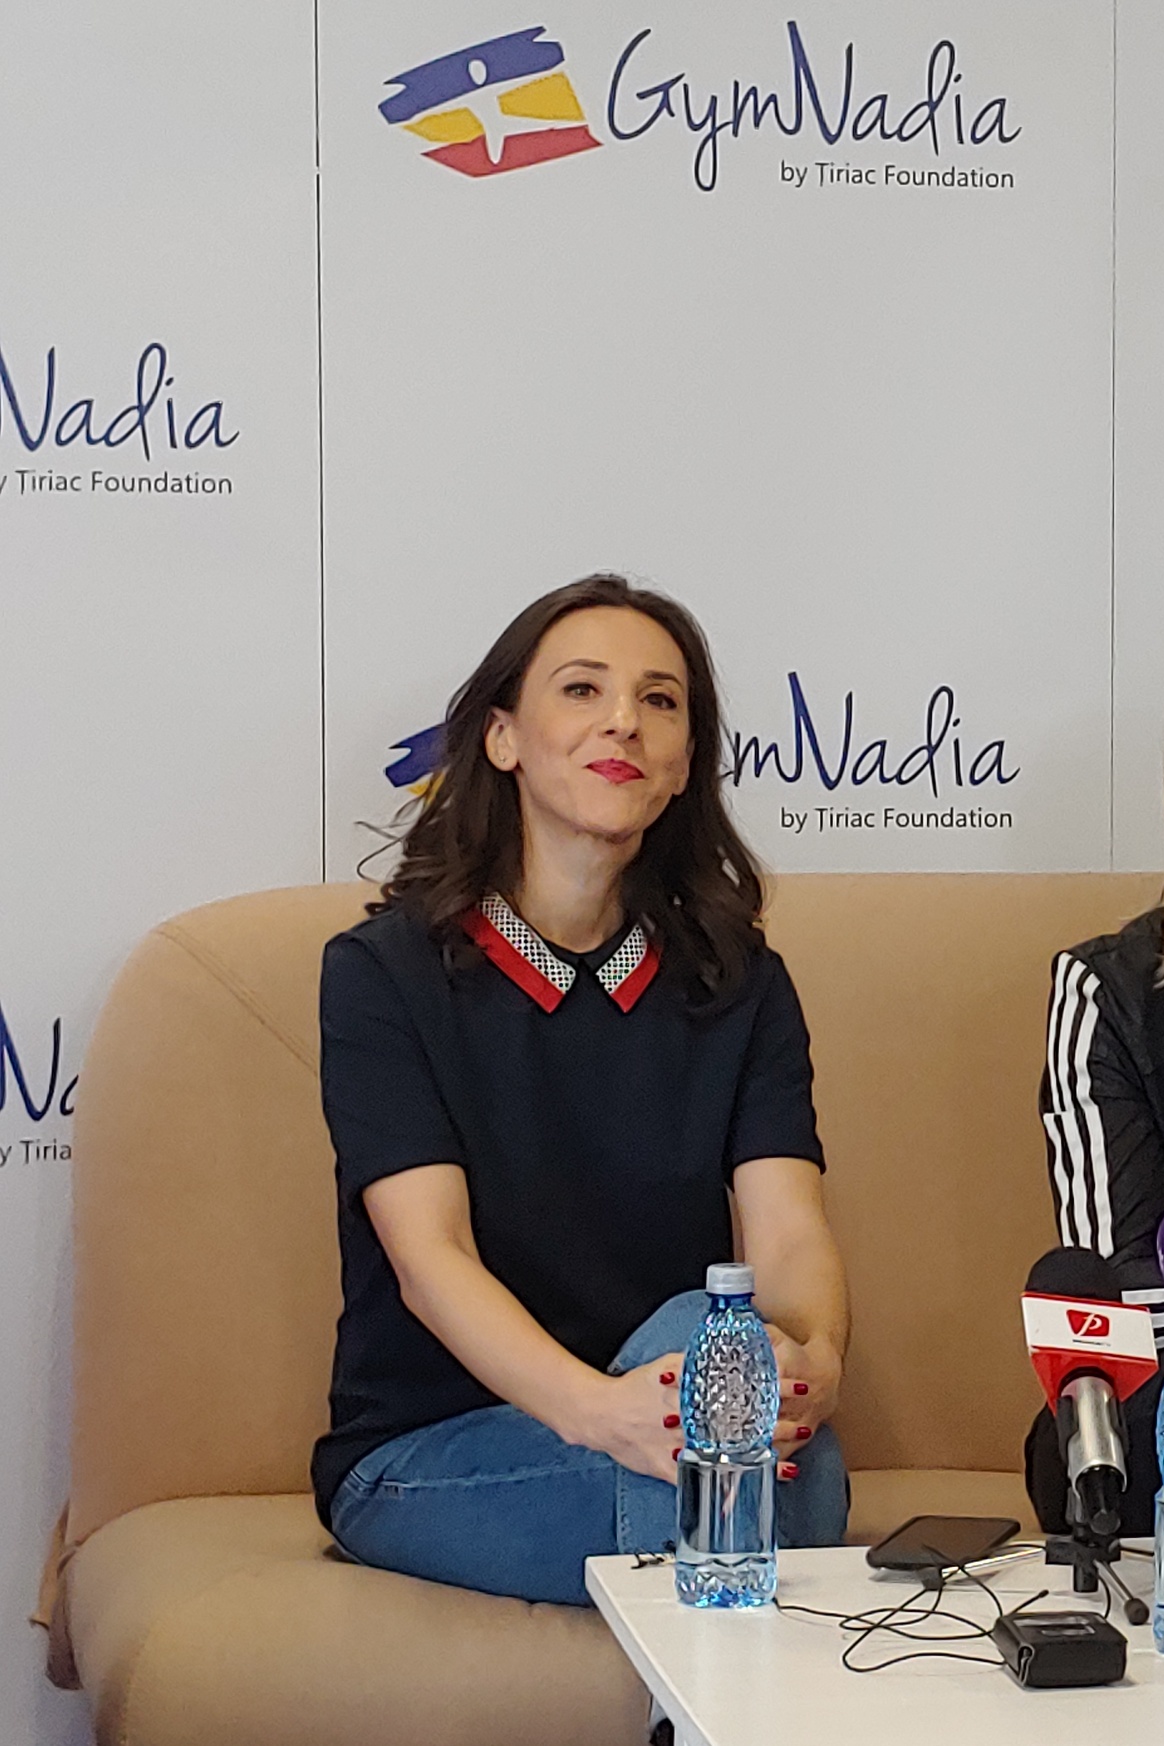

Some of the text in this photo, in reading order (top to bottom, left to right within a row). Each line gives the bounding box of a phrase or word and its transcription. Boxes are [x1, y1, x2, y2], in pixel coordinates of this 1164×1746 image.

[608, 21, 1021, 191] GymNadia
[781, 160, 1014, 188] by Tiriac Foundation
[15, 470, 81, 495] Tiriac
[91, 471, 232, 494] Foundation
[731, 672, 1020, 798] mNadia
[781, 806, 1012, 834] by Tiriac Foundation
